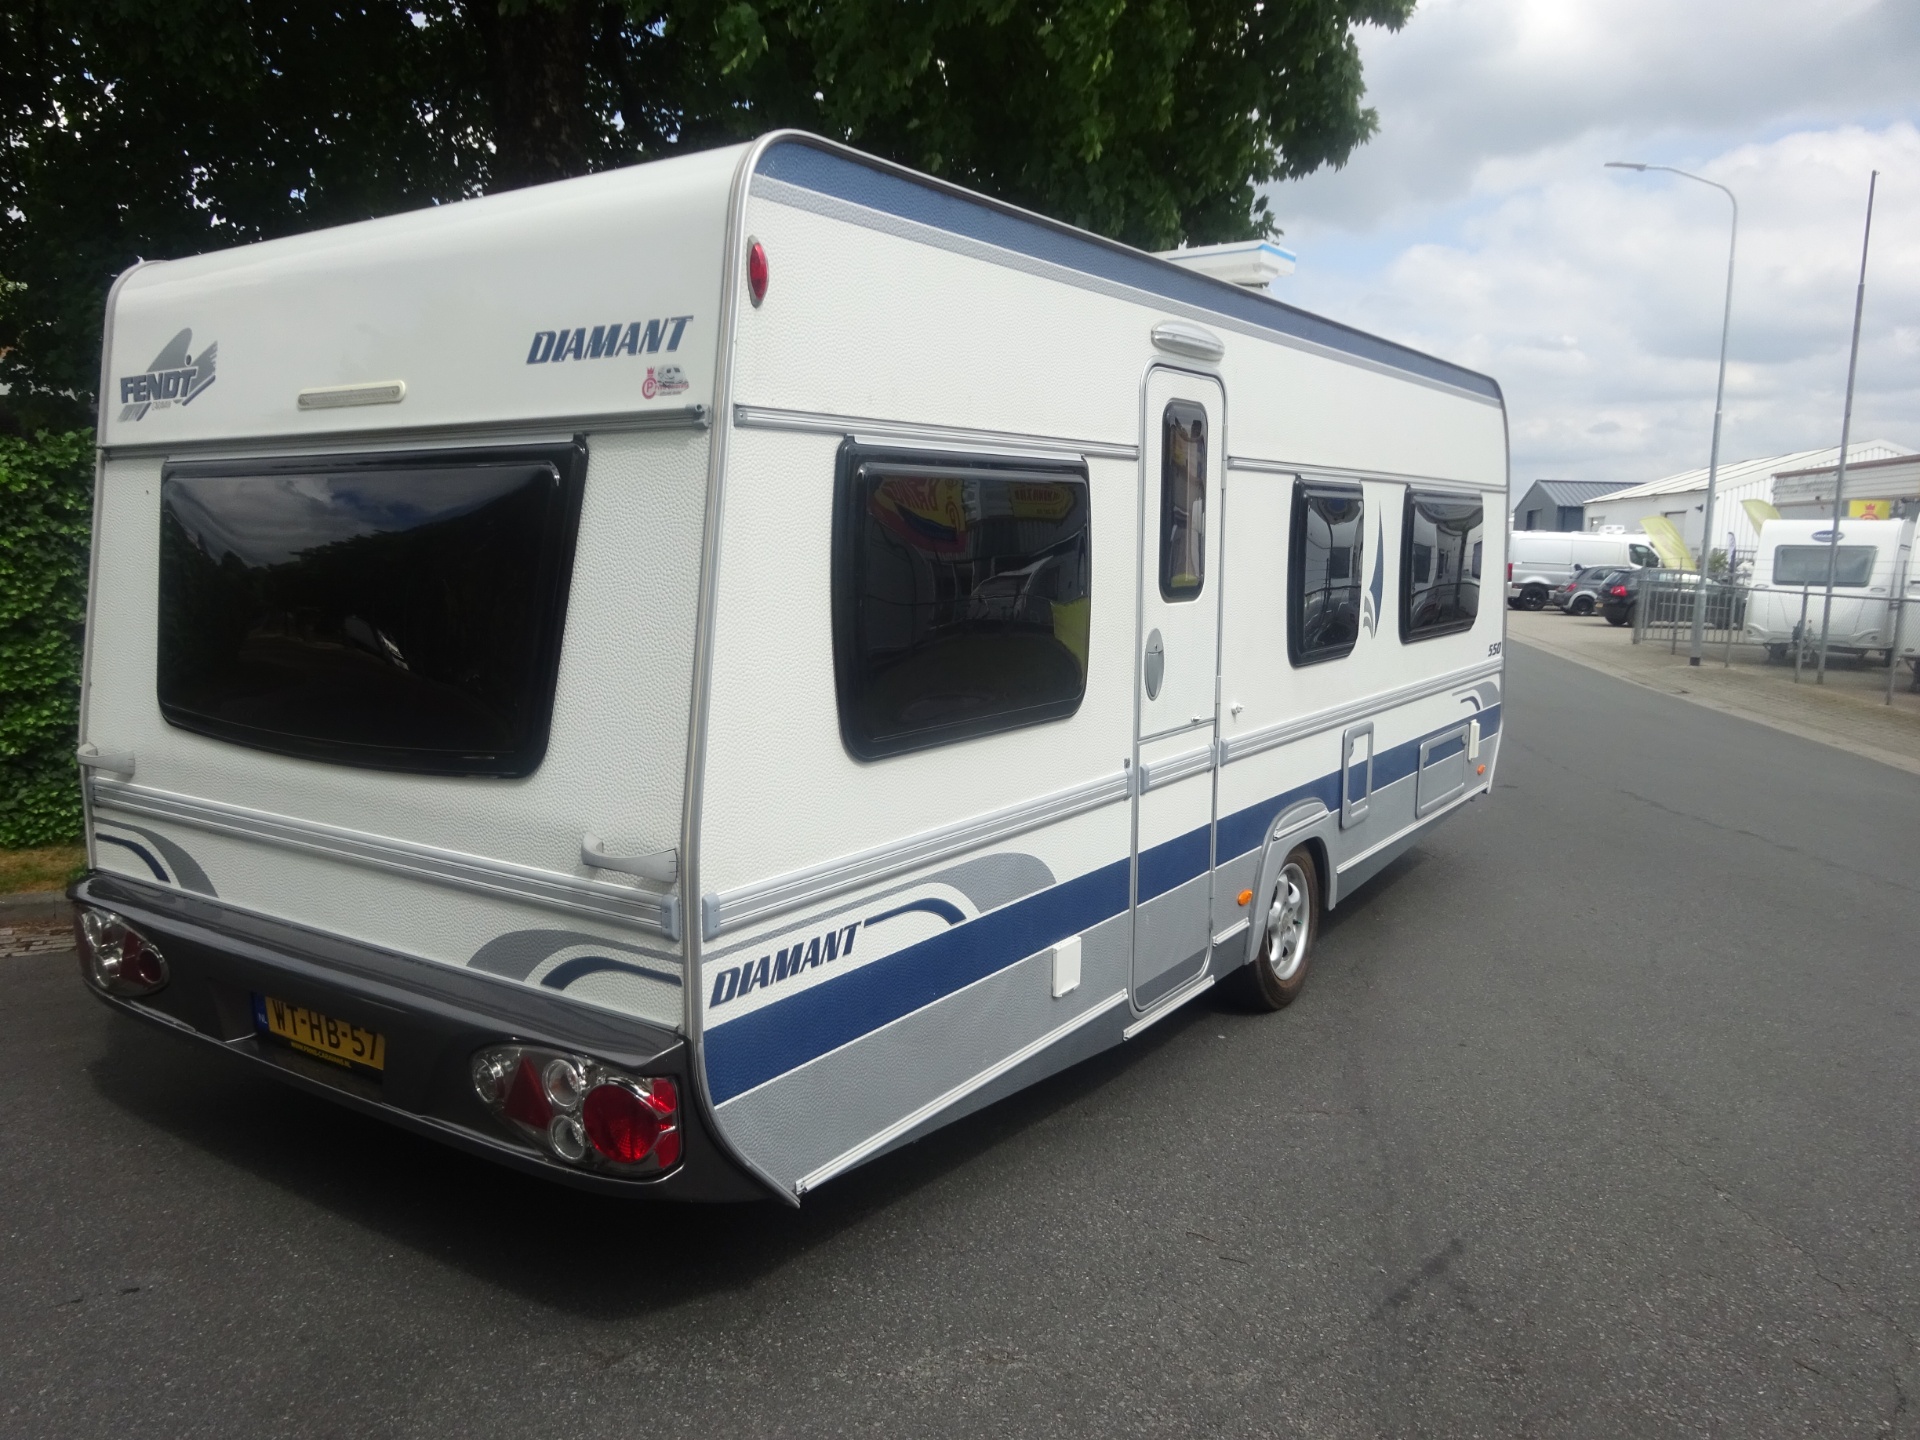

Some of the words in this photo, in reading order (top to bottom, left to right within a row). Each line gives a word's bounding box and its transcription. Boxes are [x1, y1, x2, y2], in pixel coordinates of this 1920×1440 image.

[526, 315, 694, 365] DIAMANT
[120, 368, 197, 404] FENDT
[1488, 641, 1501, 657] 550
[709, 921, 862, 1009] DIAMANT
[272, 1000, 378, 1061] WT-HB-57
